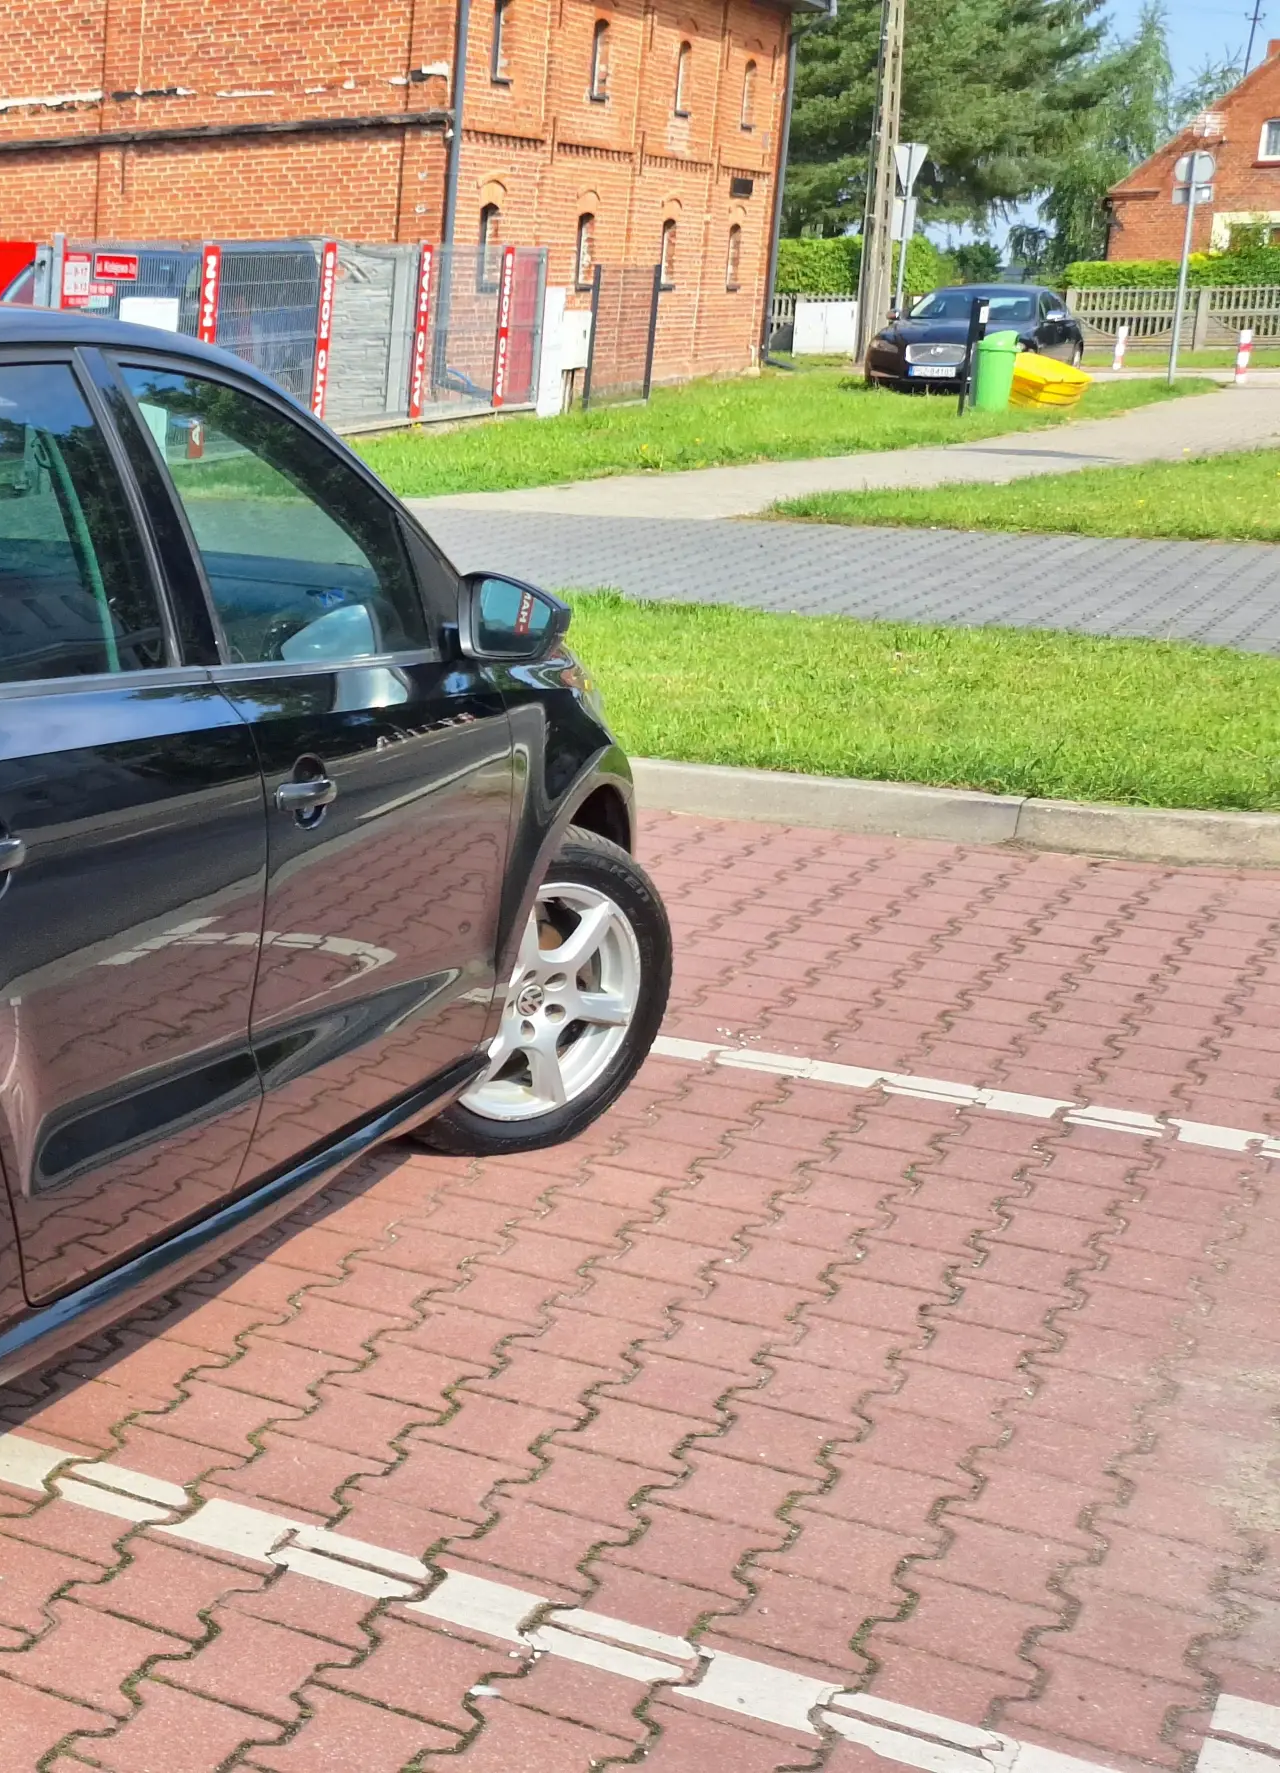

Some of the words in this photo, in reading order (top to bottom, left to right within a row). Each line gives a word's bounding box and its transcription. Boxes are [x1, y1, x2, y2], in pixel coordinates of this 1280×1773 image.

[203, 255, 216, 327] HAN
[313, 349, 327, 419] AUTO
[320, 252, 334, 339] KOMIS
[413, 331, 425, 408] AUTO
[419, 252, 431, 311] HAN
[495, 337, 507, 399] AUTO
[501, 254, 513, 328] KOMIS
